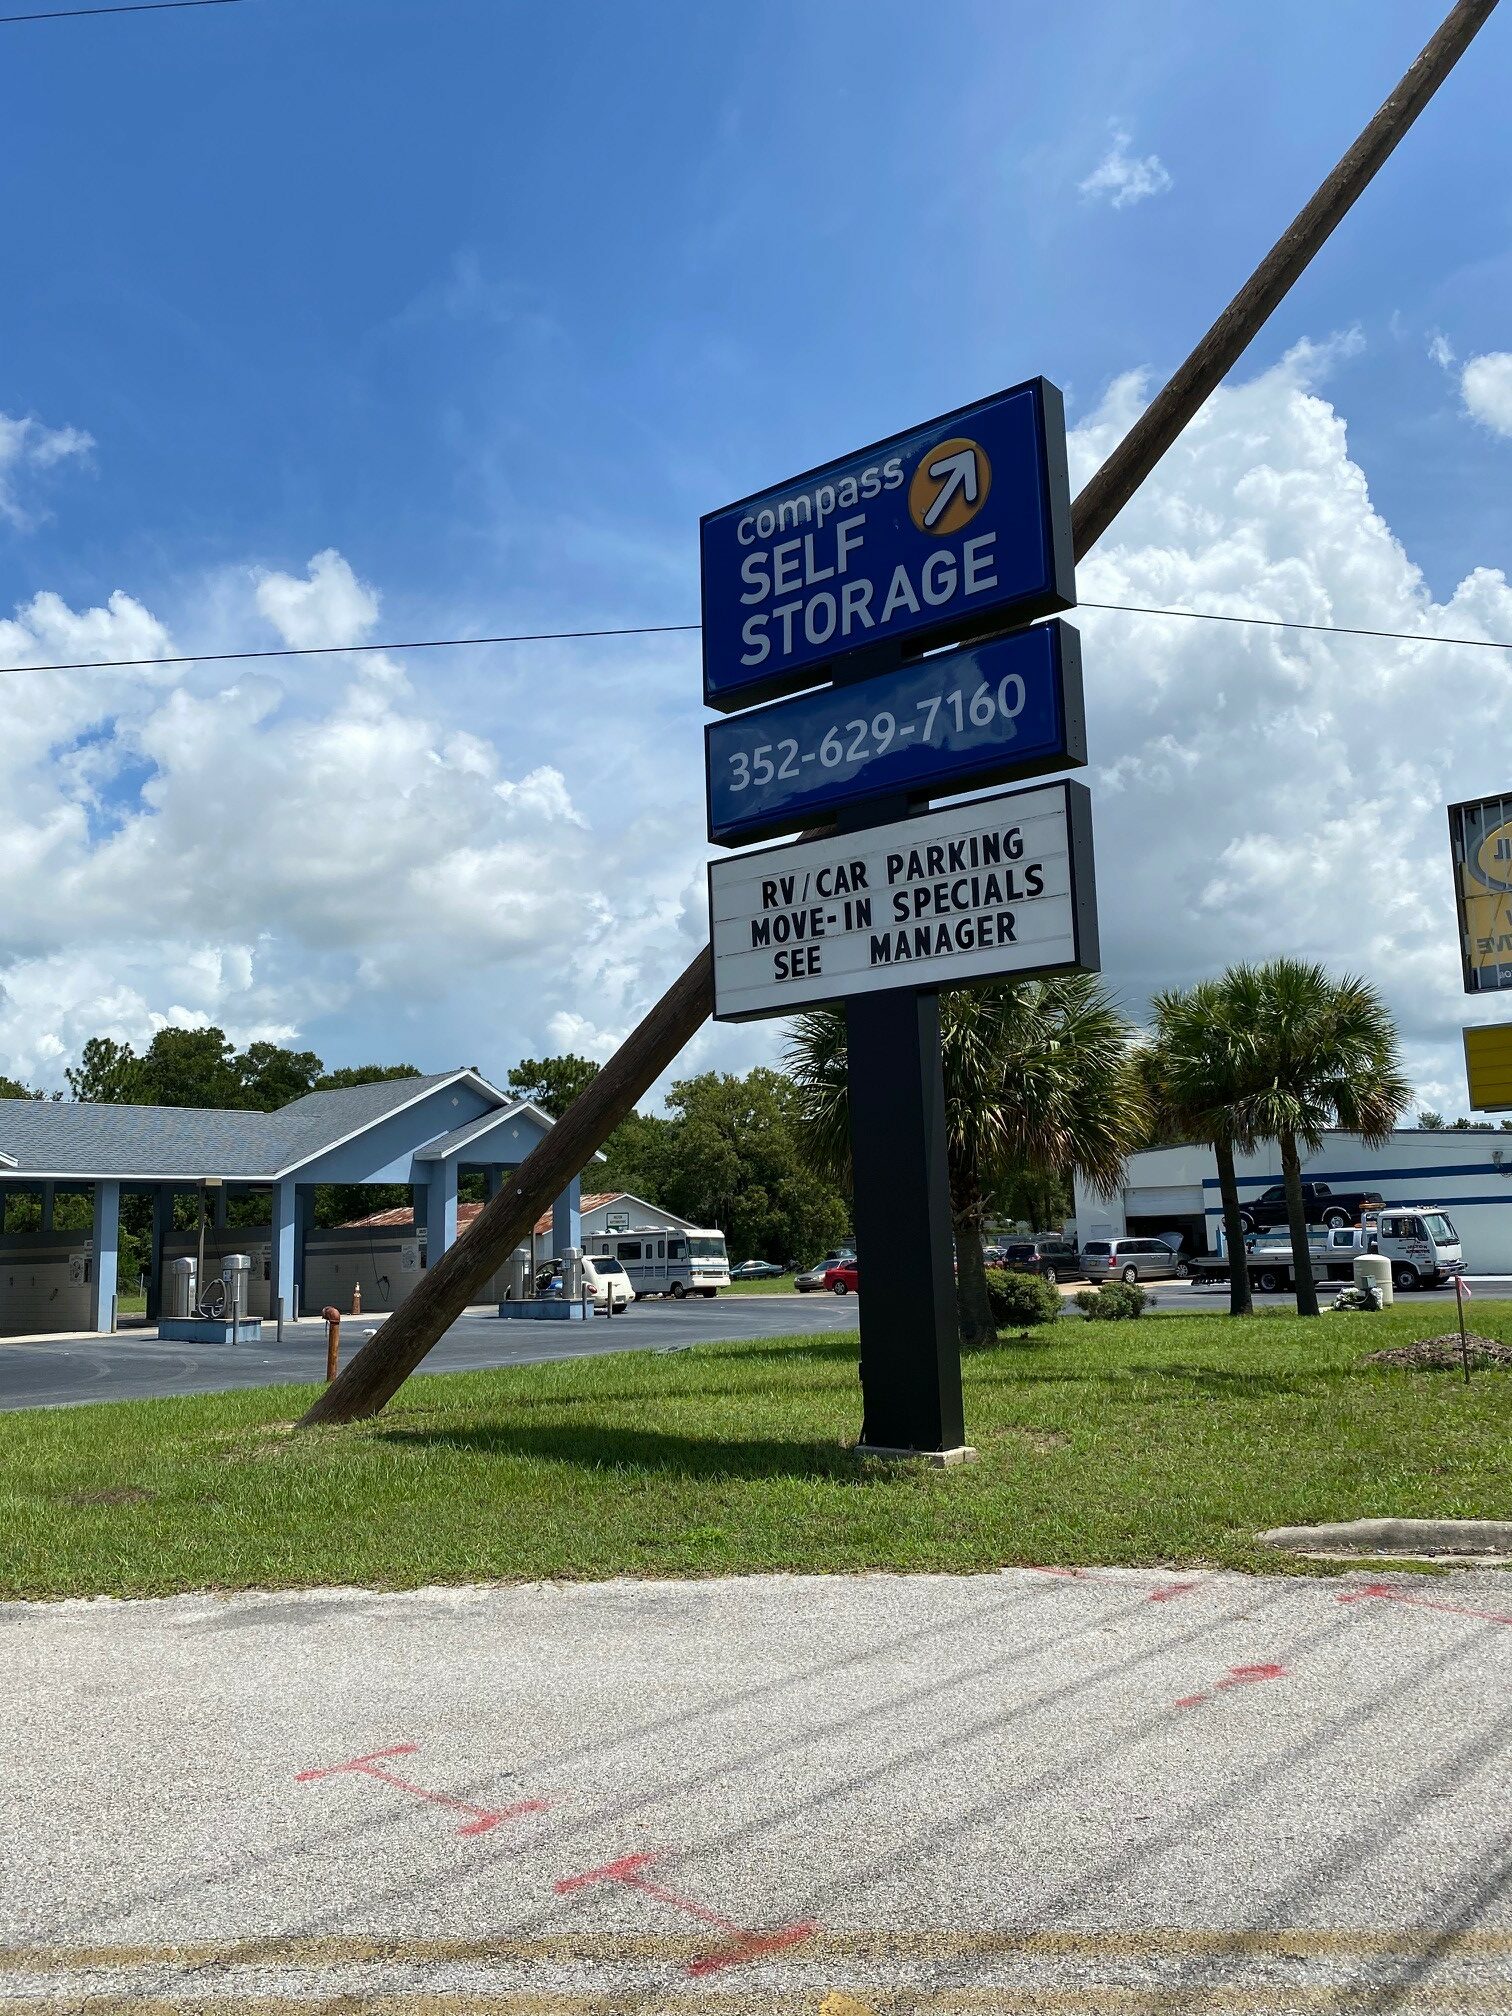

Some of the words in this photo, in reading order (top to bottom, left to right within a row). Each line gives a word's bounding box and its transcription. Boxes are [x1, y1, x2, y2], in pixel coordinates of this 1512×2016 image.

[737, 457, 905, 545] compass
[739, 513, 867, 605] SELF
[739, 532, 998, 666] STORAGE
[728, 673, 1026, 792] 352-629-7160
[887, 827, 1024, 885] PARKING
[751, 898, 872, 948] MOVE-IN
[893, 864, 1044, 923] SPECIALS
[773, 945, 822, 980] SEE
[870, 911, 1017, 965] MANAGER
